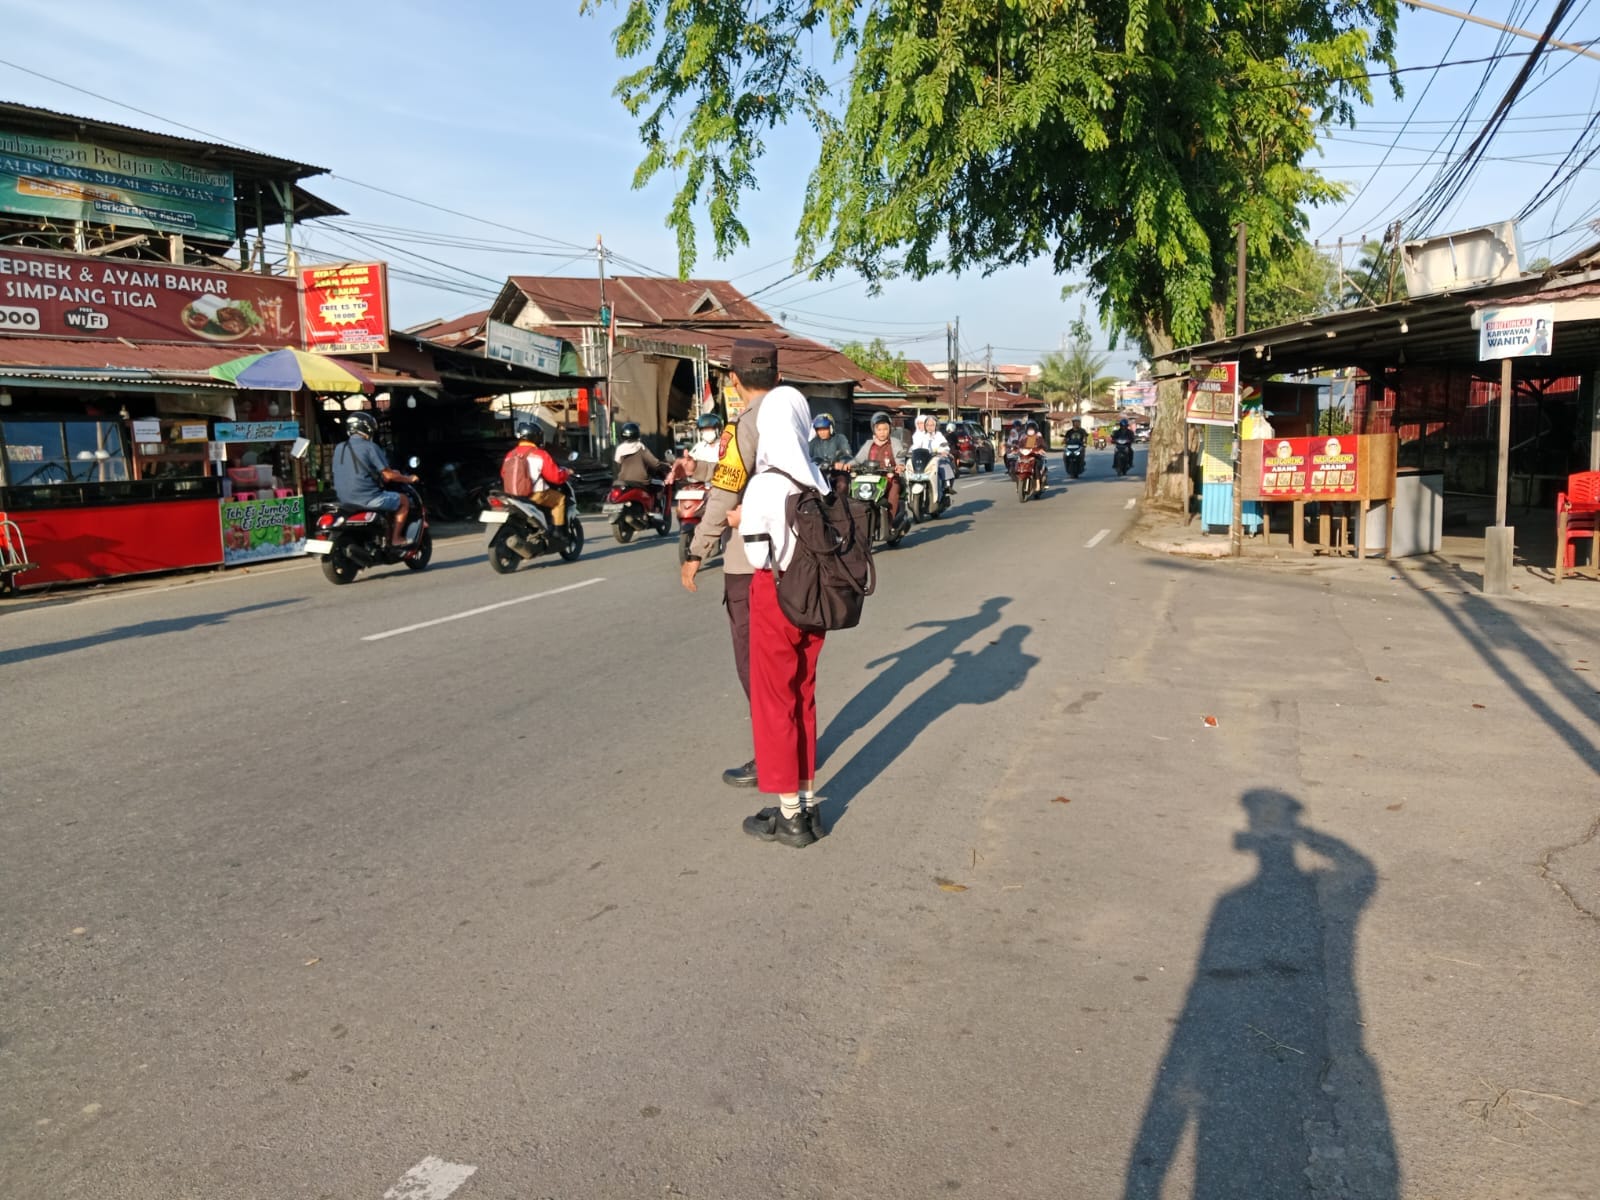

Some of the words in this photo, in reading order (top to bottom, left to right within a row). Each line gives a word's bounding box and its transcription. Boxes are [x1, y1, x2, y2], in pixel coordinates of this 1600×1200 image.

[161, 162, 176, 177] &
[2, 258, 72, 281] EPREK
[79, 266, 94, 283] &
[102, 269, 160, 288] AYAM
[165, 274, 228, 294] BAKAR
[6, 281, 106, 304] SIMPANG
[111, 290, 157, 309] TIGA
[1487, 335, 1529, 348] WANITA
[226, 507, 242, 519] Teh
[259, 503, 289, 516] Jumbo
[292, 501, 299, 513] &
